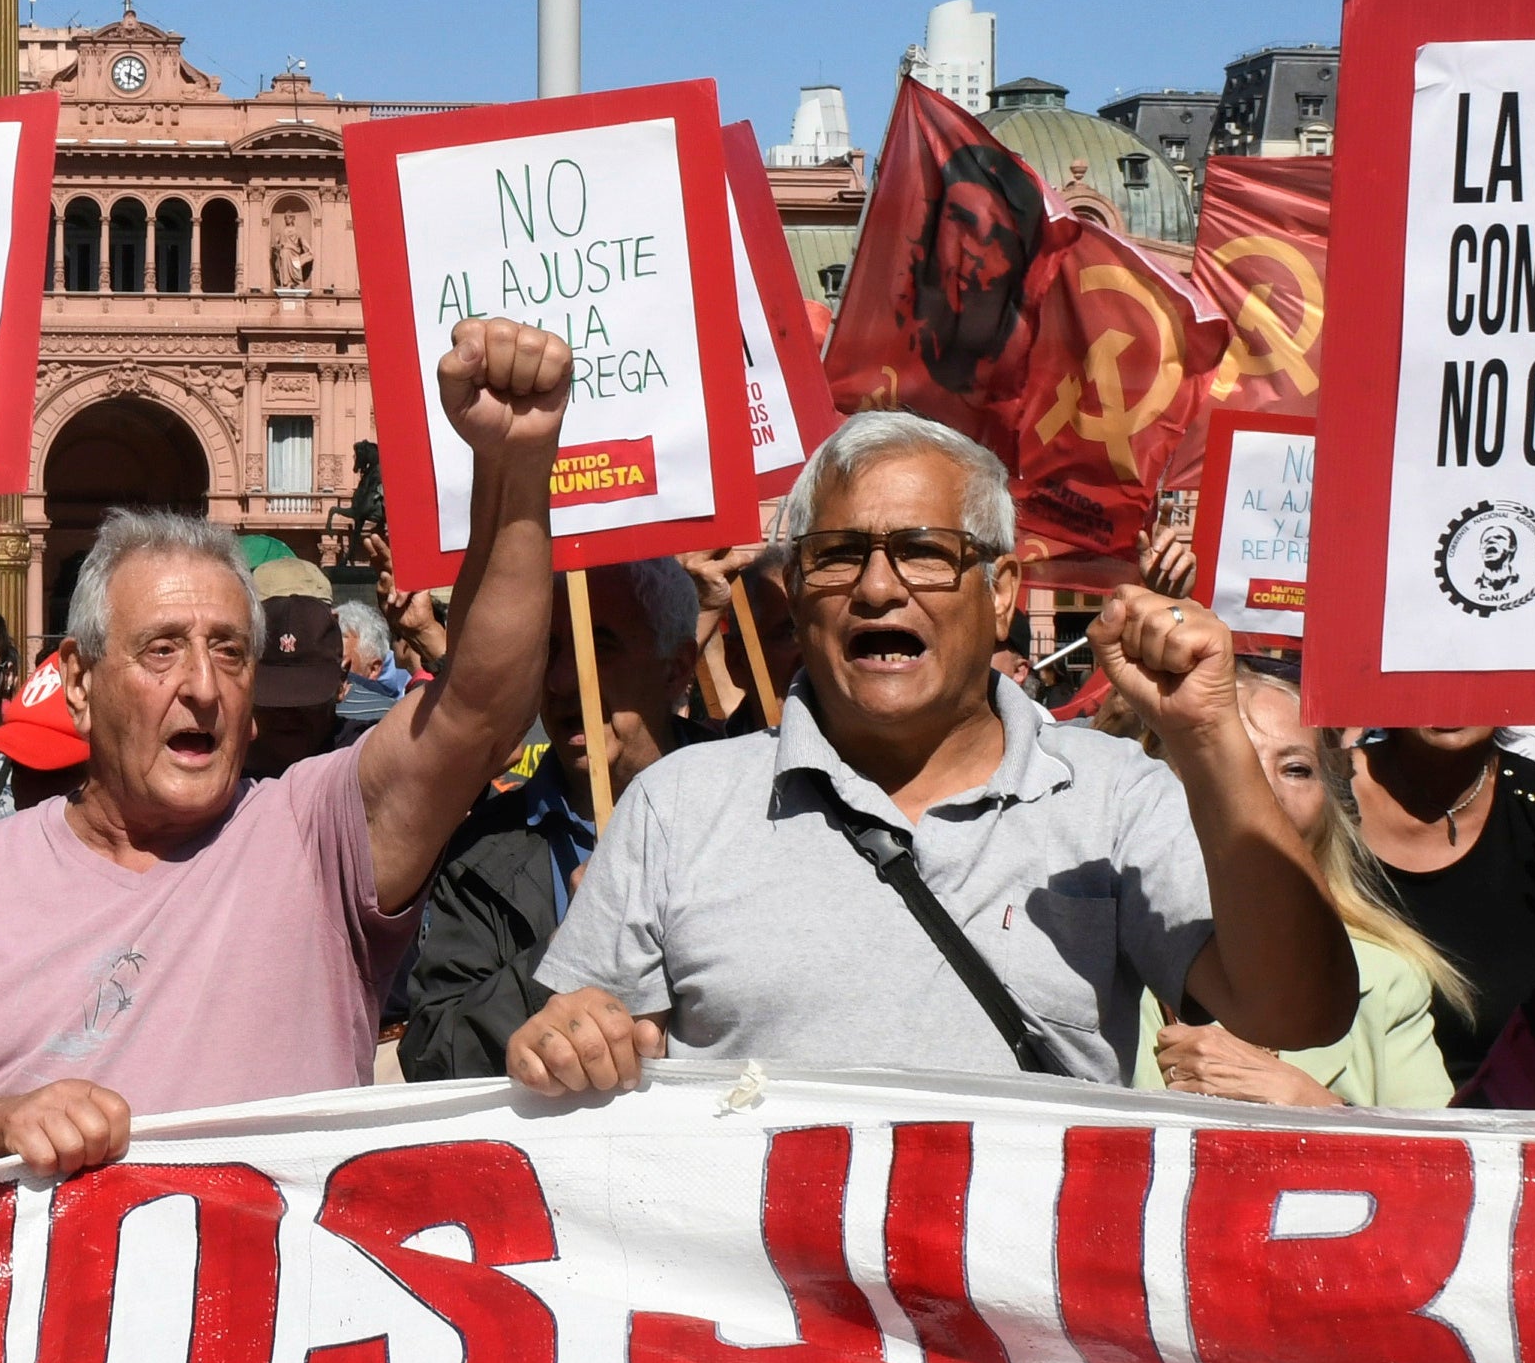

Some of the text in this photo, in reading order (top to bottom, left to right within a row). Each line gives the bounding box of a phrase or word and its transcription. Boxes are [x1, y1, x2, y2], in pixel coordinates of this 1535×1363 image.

[1453, 91, 1523, 204] LA
[496, 159, 587, 249] NO
[439, 236, 658, 325] AL AJUSTE
[566, 305, 610, 350] LA
[571, 348, 668, 403] REGA
[1437, 357, 1509, 468] NO
[552, 453, 610, 473] ARTIDO
[1242, 489, 1267, 512] AL
[1473, 512, 1509, 525] NACIONAL
[1273, 518, 1285, 537] Y
